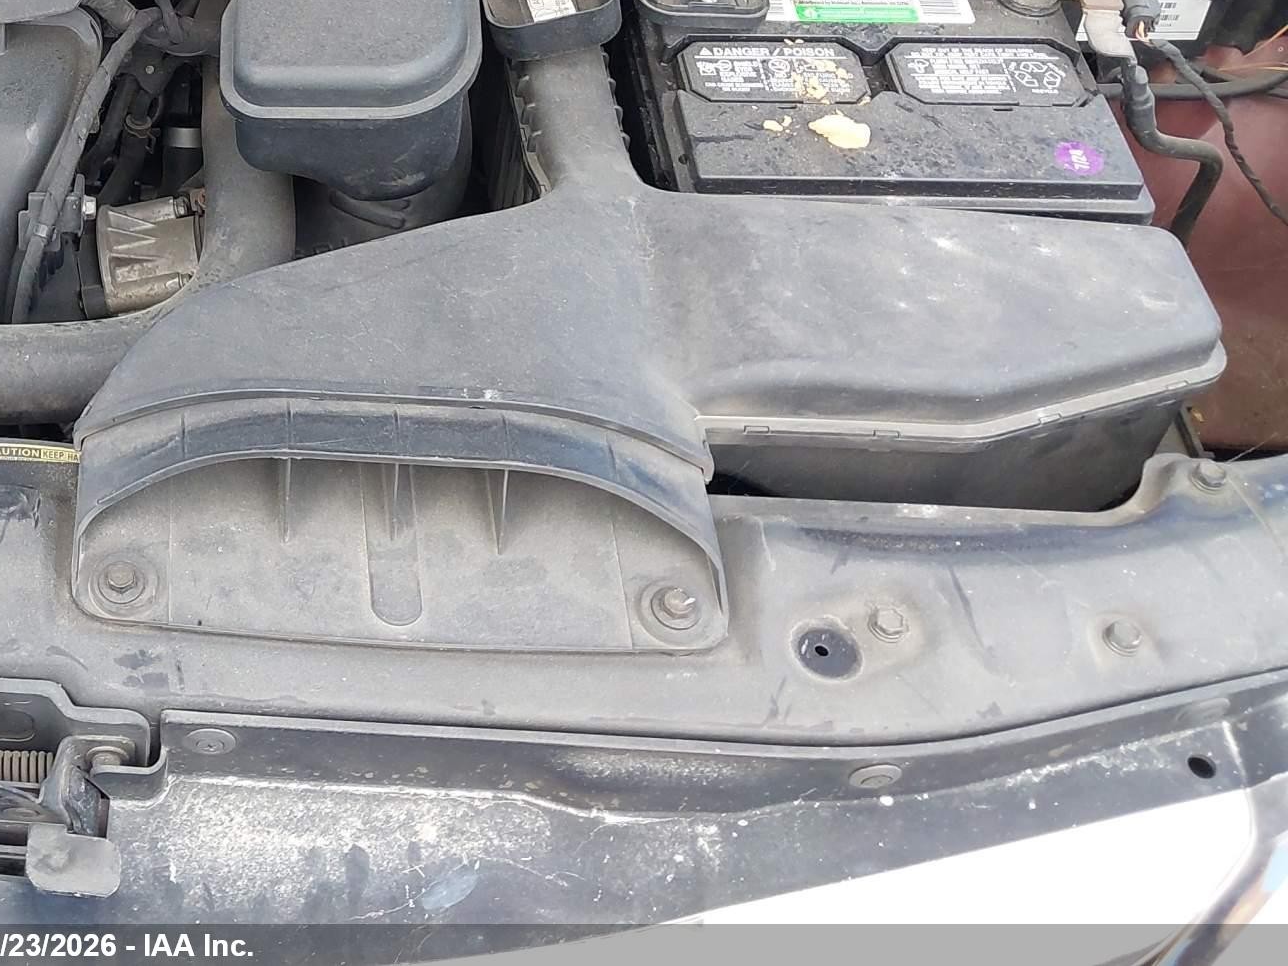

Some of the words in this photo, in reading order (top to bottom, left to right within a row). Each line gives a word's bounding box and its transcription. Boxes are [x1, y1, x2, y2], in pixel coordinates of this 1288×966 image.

[712, 47, 771, 56] DANGER
[783, 47, 835, 56] POISON
[43, 449, 66, 460] KEEP
